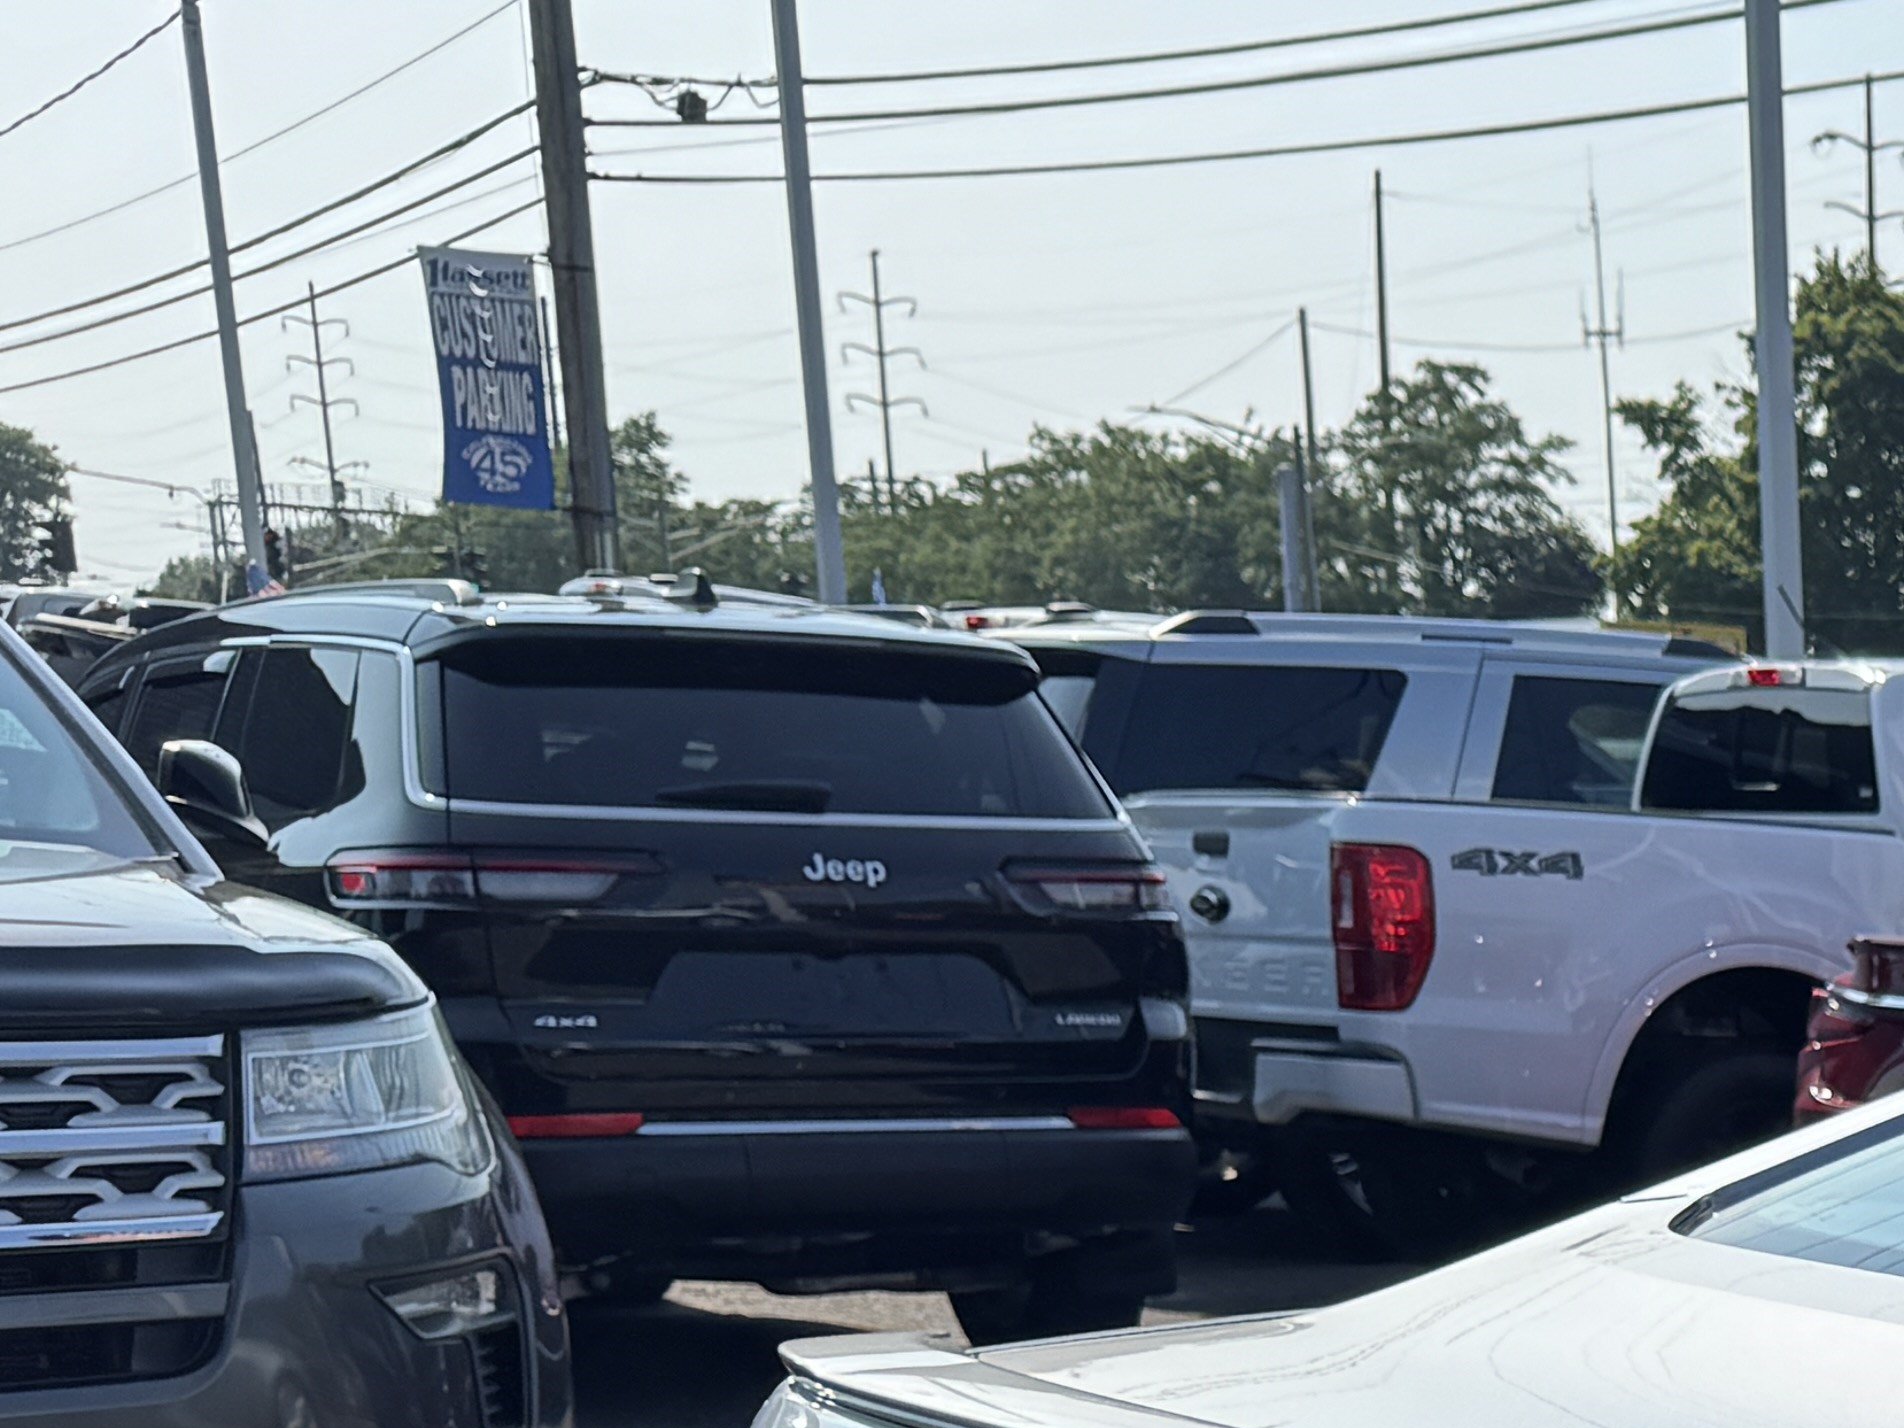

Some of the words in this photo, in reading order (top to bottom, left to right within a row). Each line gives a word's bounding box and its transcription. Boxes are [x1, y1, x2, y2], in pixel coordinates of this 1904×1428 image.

[432, 293, 539, 366] CUSTOMER
[451, 365, 536, 436] PARKING
[802, 852, 888, 889] Jeep
